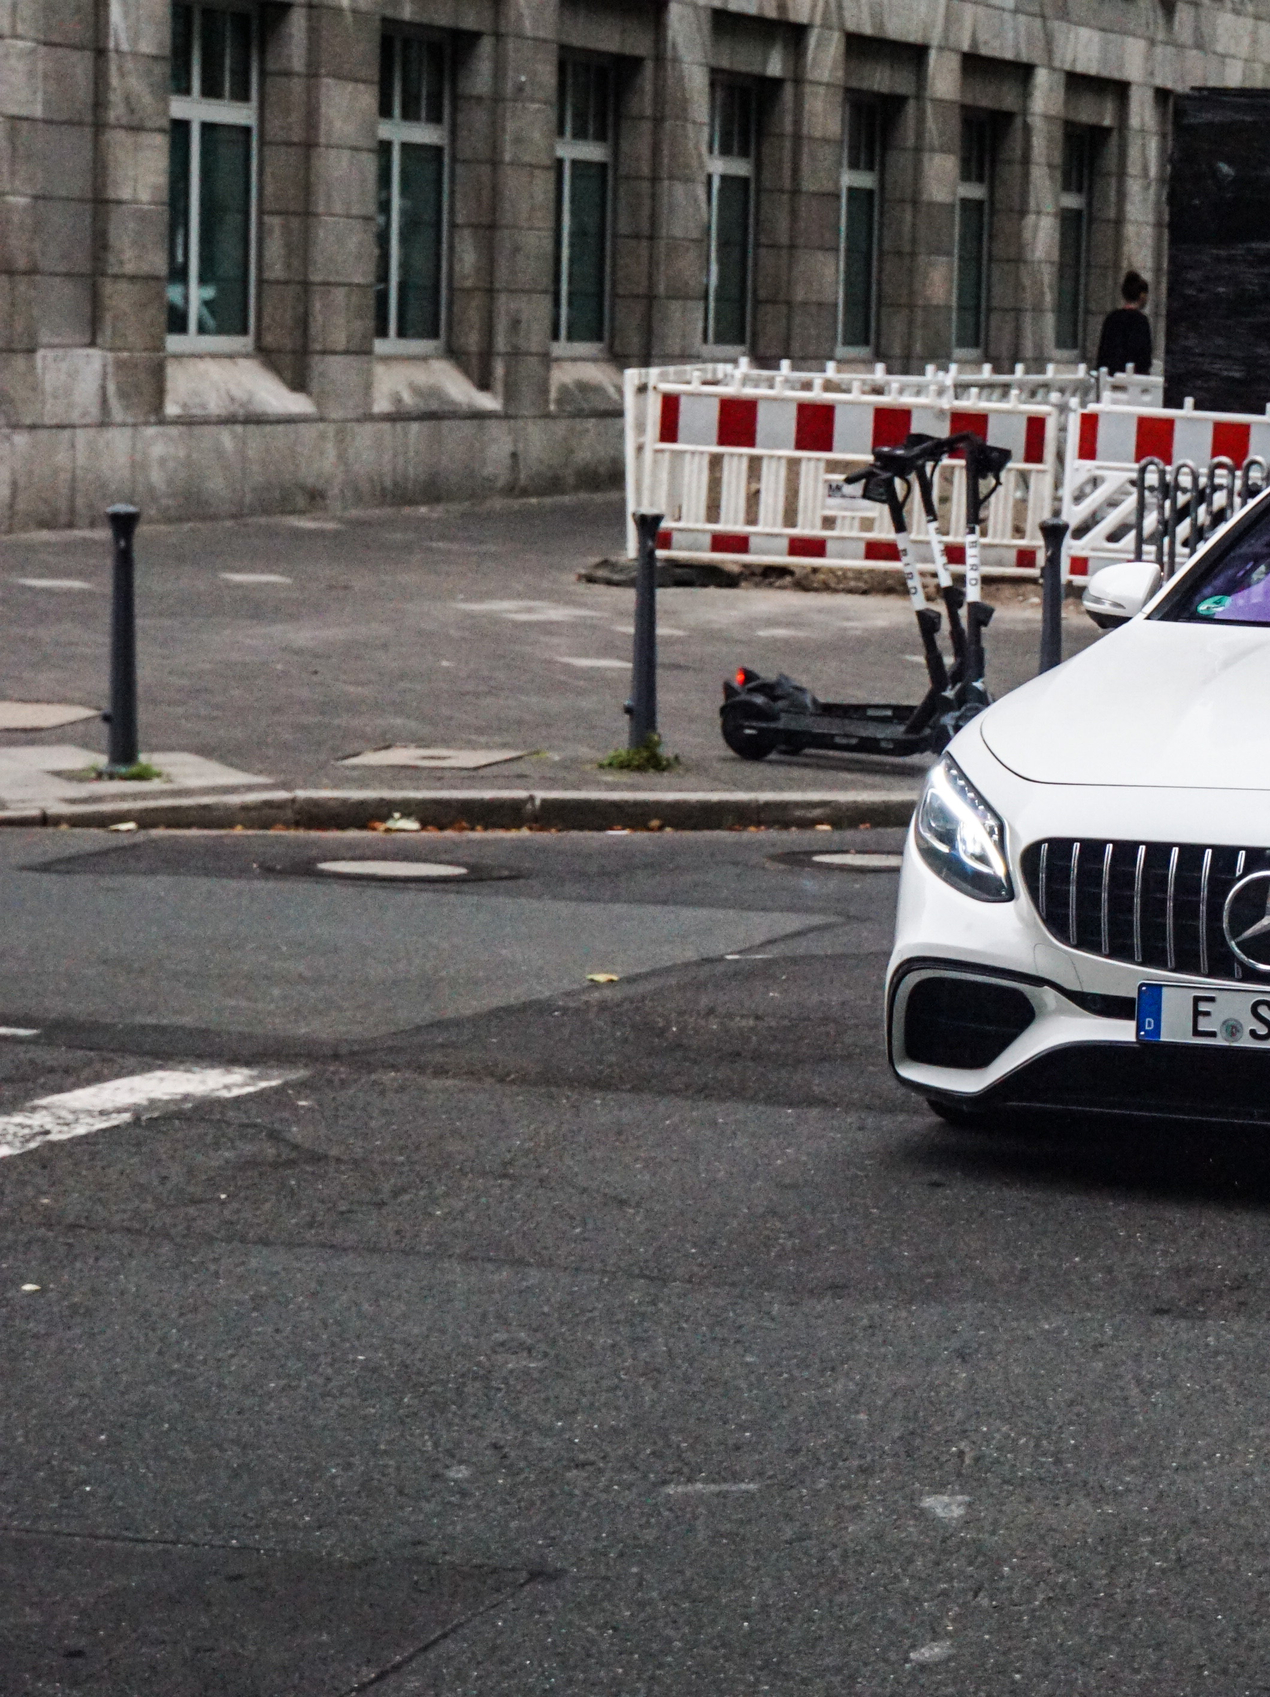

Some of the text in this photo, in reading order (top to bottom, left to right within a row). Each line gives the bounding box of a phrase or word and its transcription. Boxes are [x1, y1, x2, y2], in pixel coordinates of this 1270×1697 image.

[968, 540, 979, 587] BIRD
[1144, 1017, 1154, 1030] D
[1191, 994, 1218, 1038] E
